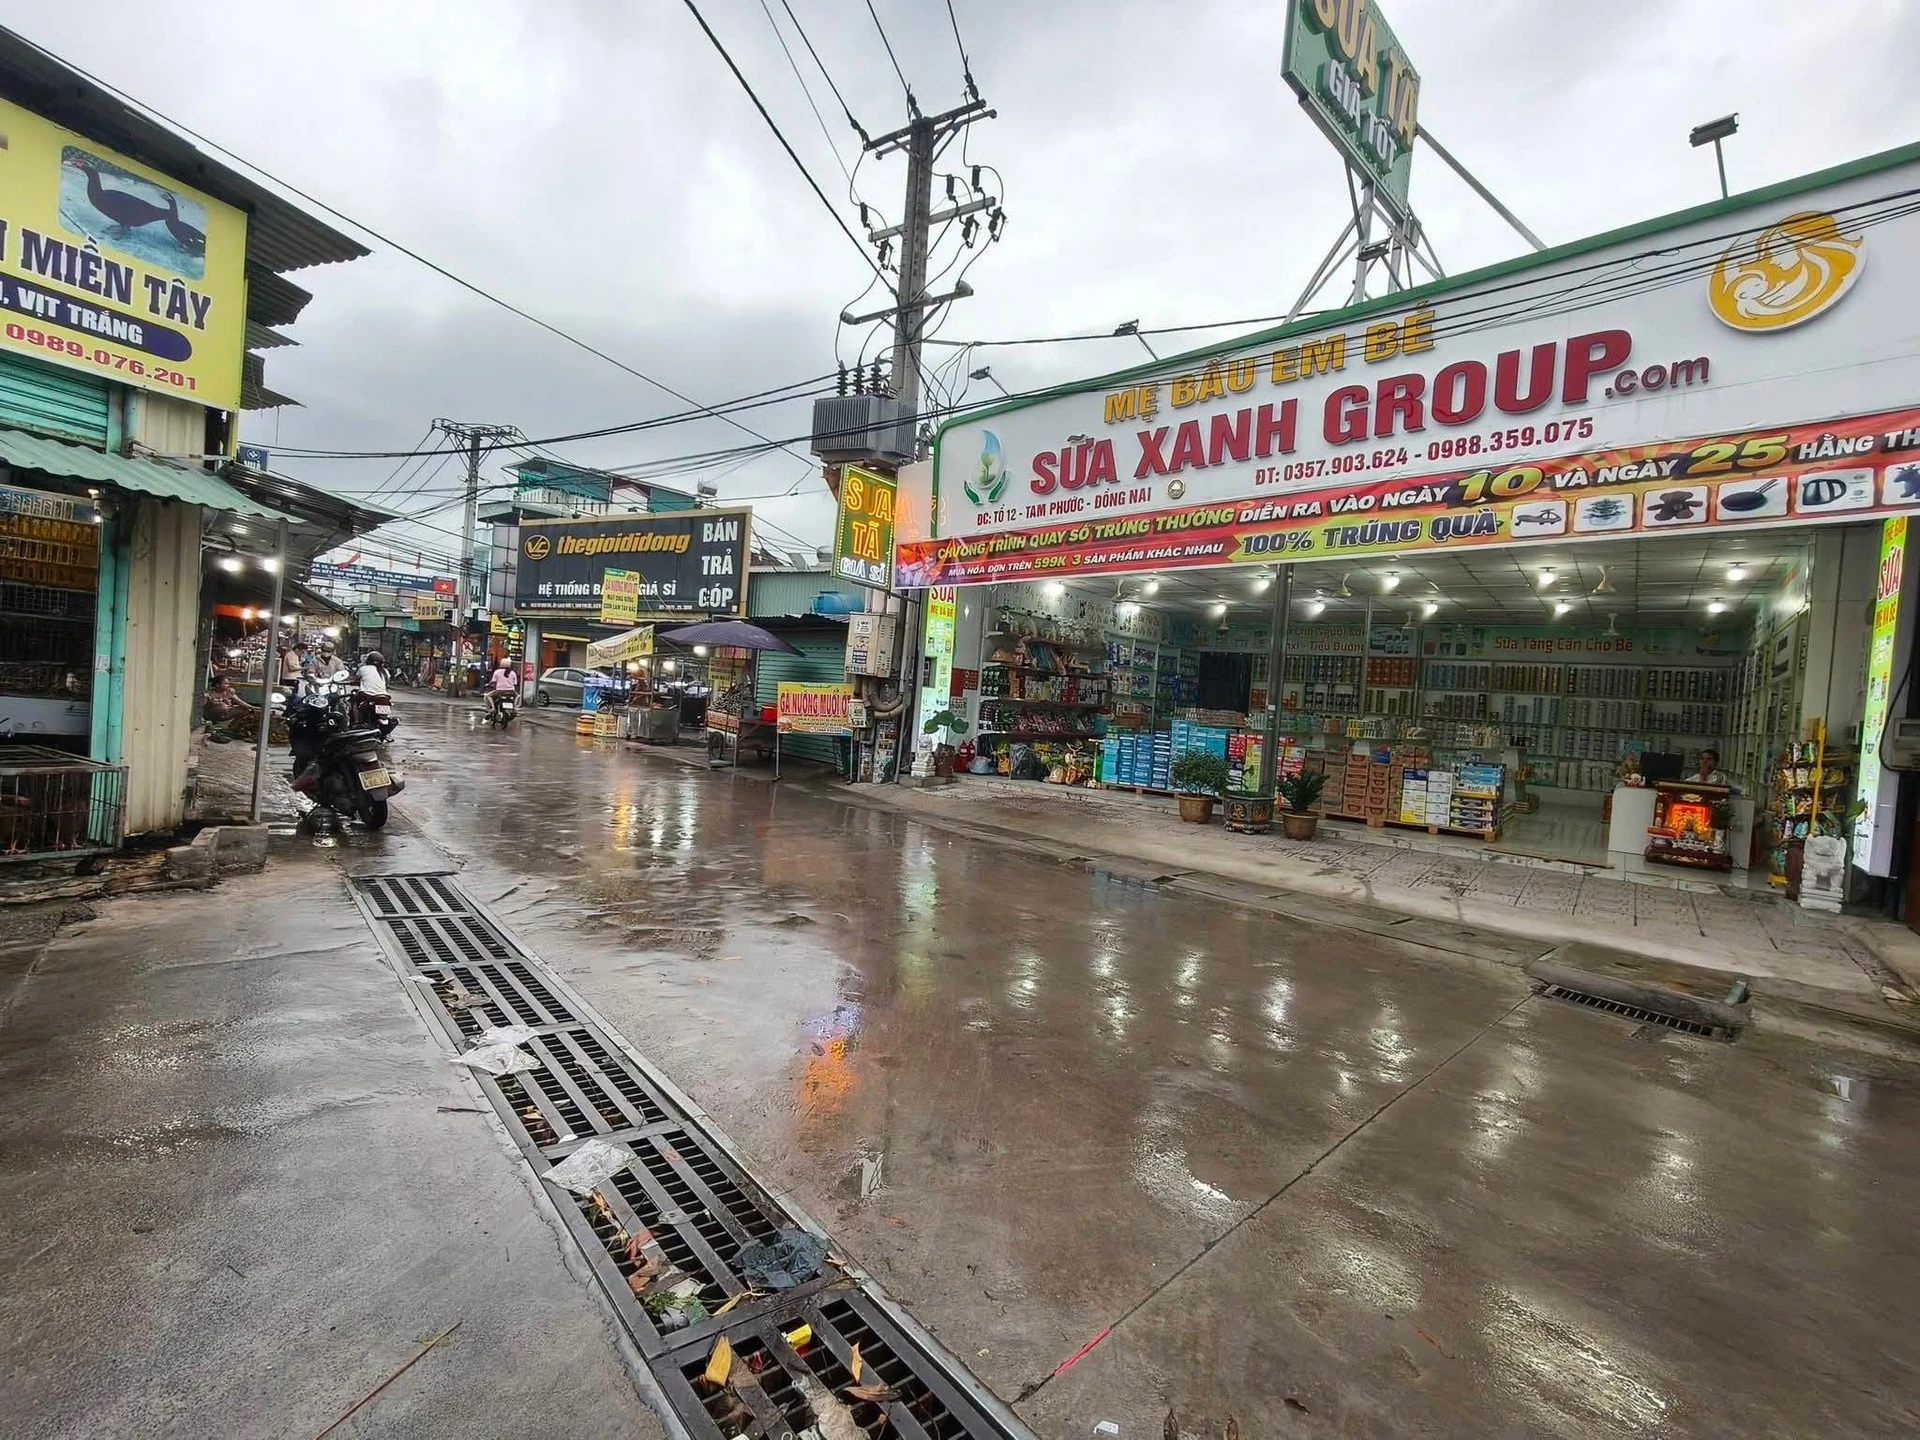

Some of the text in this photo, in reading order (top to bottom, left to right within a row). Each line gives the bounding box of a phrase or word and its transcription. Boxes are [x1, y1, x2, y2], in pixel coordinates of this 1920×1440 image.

[21, 228, 134, 305] MIỀN
[144, 273, 211, 331] TÂY
[18, 286, 61, 320] VỊT
[67, 303, 144, 345] TRẮNG
[6, 322, 197, 391] 0989.076.201
[1104, 383, 1160, 422] MẸ
[1271, 333, 1346, 385] EM
[1364, 300, 1436, 363] BÉ
[1030, 434, 1119, 495] SỮA
[1134, 398, 1298, 478] XANH
[1255, 469, 1280, 486] ĐT:
[1284, 447, 1408, 482] 0357.903.624
[1427, 416, 1593, 461] 0988.359.075
[977, 512, 992, 526] ĐC:
[993, 504, 1005, 524] TỔ
[1006, 508, 1016, 521] 12
[1025, 503, 1046, 519] TAM
[1049, 496, 1084, 516] PHƯỚC
[1094, 488, 1127, 510] ĐỒNG
[1129, 486, 1151, 504] NAI
[988, 534, 1026, 554] TRÌNH
[1029, 530, 1067, 548] QUAY
[1068, 523, 1093, 543] SỐ
[1094, 519, 1150, 540] TRÚNG
[1238, 501, 1288, 524] DIỄN
[1292, 501, 1322, 518] RA
[1330, 491, 1376, 514] VÀO
[1381, 481, 1450, 508] NGÀY
[1458, 467, 1545, 501] 10
[1554, 467, 1589, 488] VÀ
[1597, 456, 1679, 485] NGÀY
[1687, 435, 1791, 475] 25
[557, 532, 691, 556] thegioididong
[702, 517, 738, 543] BÁN
[853, 520, 880, 560] TÃ
[1242, 529, 1315, 556] 100%
[1428, 508, 1499, 543] QUÀ
[701, 548, 734, 576] TRẢ
[948, 567, 966, 577] MUA
[987, 563, 1006, 574] ĐƠN
[1008, 559, 1032, 572] TRÊN
[1034, 555, 1067, 570] 599K
[1071, 554, 1082, 567] 3
[1109, 547, 1144, 563] PHẨM
[1146, 543, 1183, 559] KHÁC
[1184, 543, 1224, 556] NHAU
[538, 581, 553, 598] HỆ
[554, 580, 590, 597] THỐNG
[780, 686, 791, 713] GÀ
